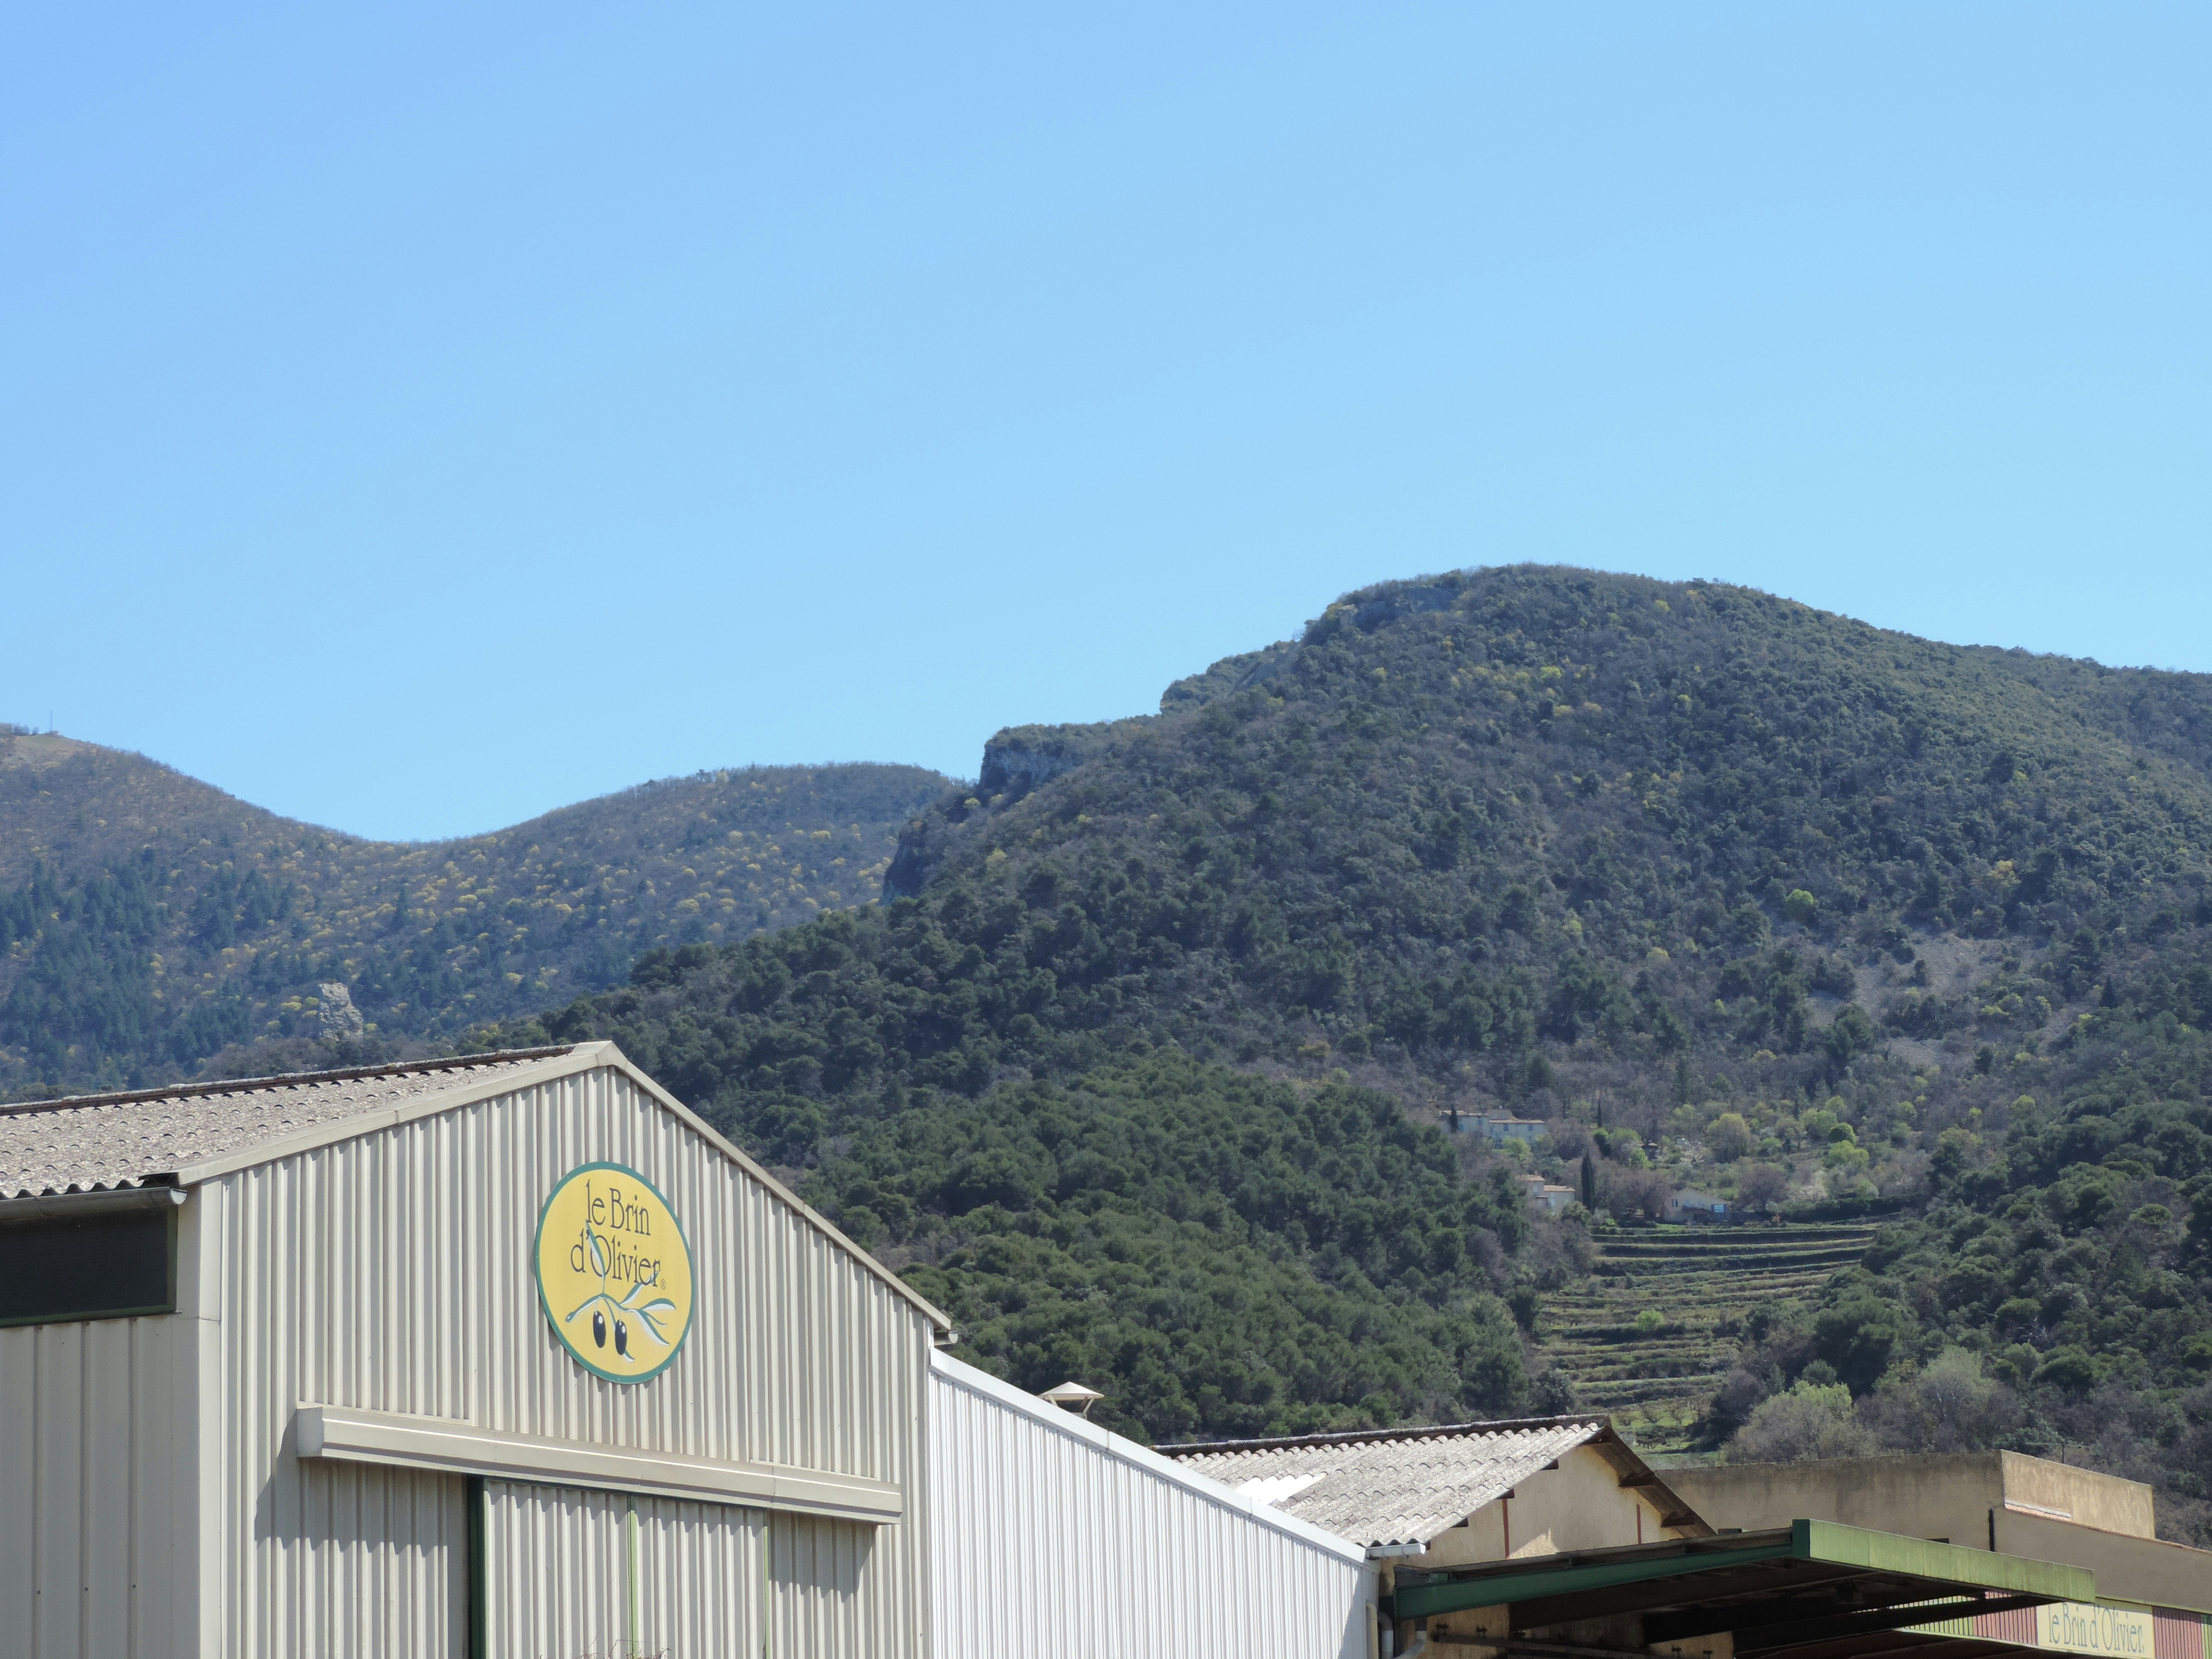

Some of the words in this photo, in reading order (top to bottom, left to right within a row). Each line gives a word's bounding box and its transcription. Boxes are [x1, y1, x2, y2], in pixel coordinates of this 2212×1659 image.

[586, 1178, 606, 1226] le
[609, 1187, 651, 1236] Brin
[2048, 1604, 2060, 1645] le
[2062, 1602, 2087, 1647] Brin
